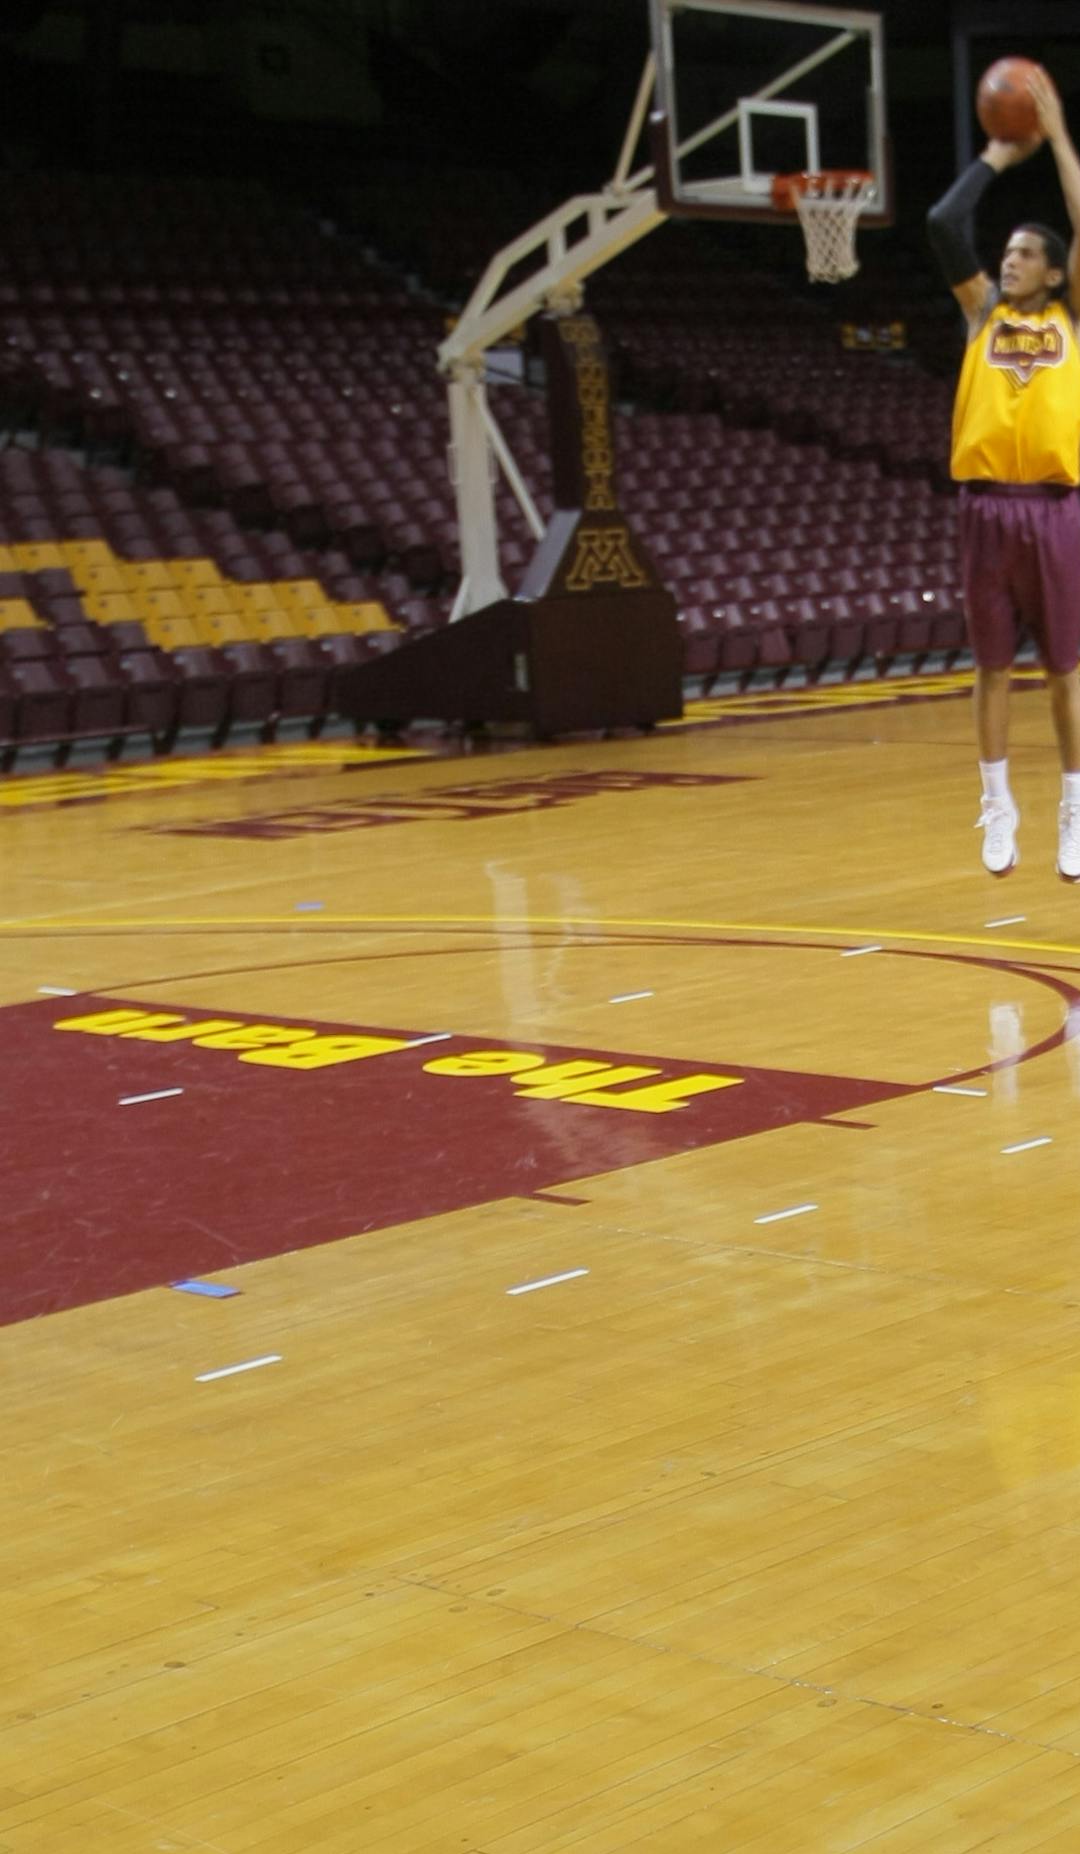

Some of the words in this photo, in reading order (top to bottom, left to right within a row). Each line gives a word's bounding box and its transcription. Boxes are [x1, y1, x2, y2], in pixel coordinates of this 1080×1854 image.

[566, 530, 646, 590] M
[53, 1009, 420, 1070] Barn
[422, 1050, 745, 1113] The
